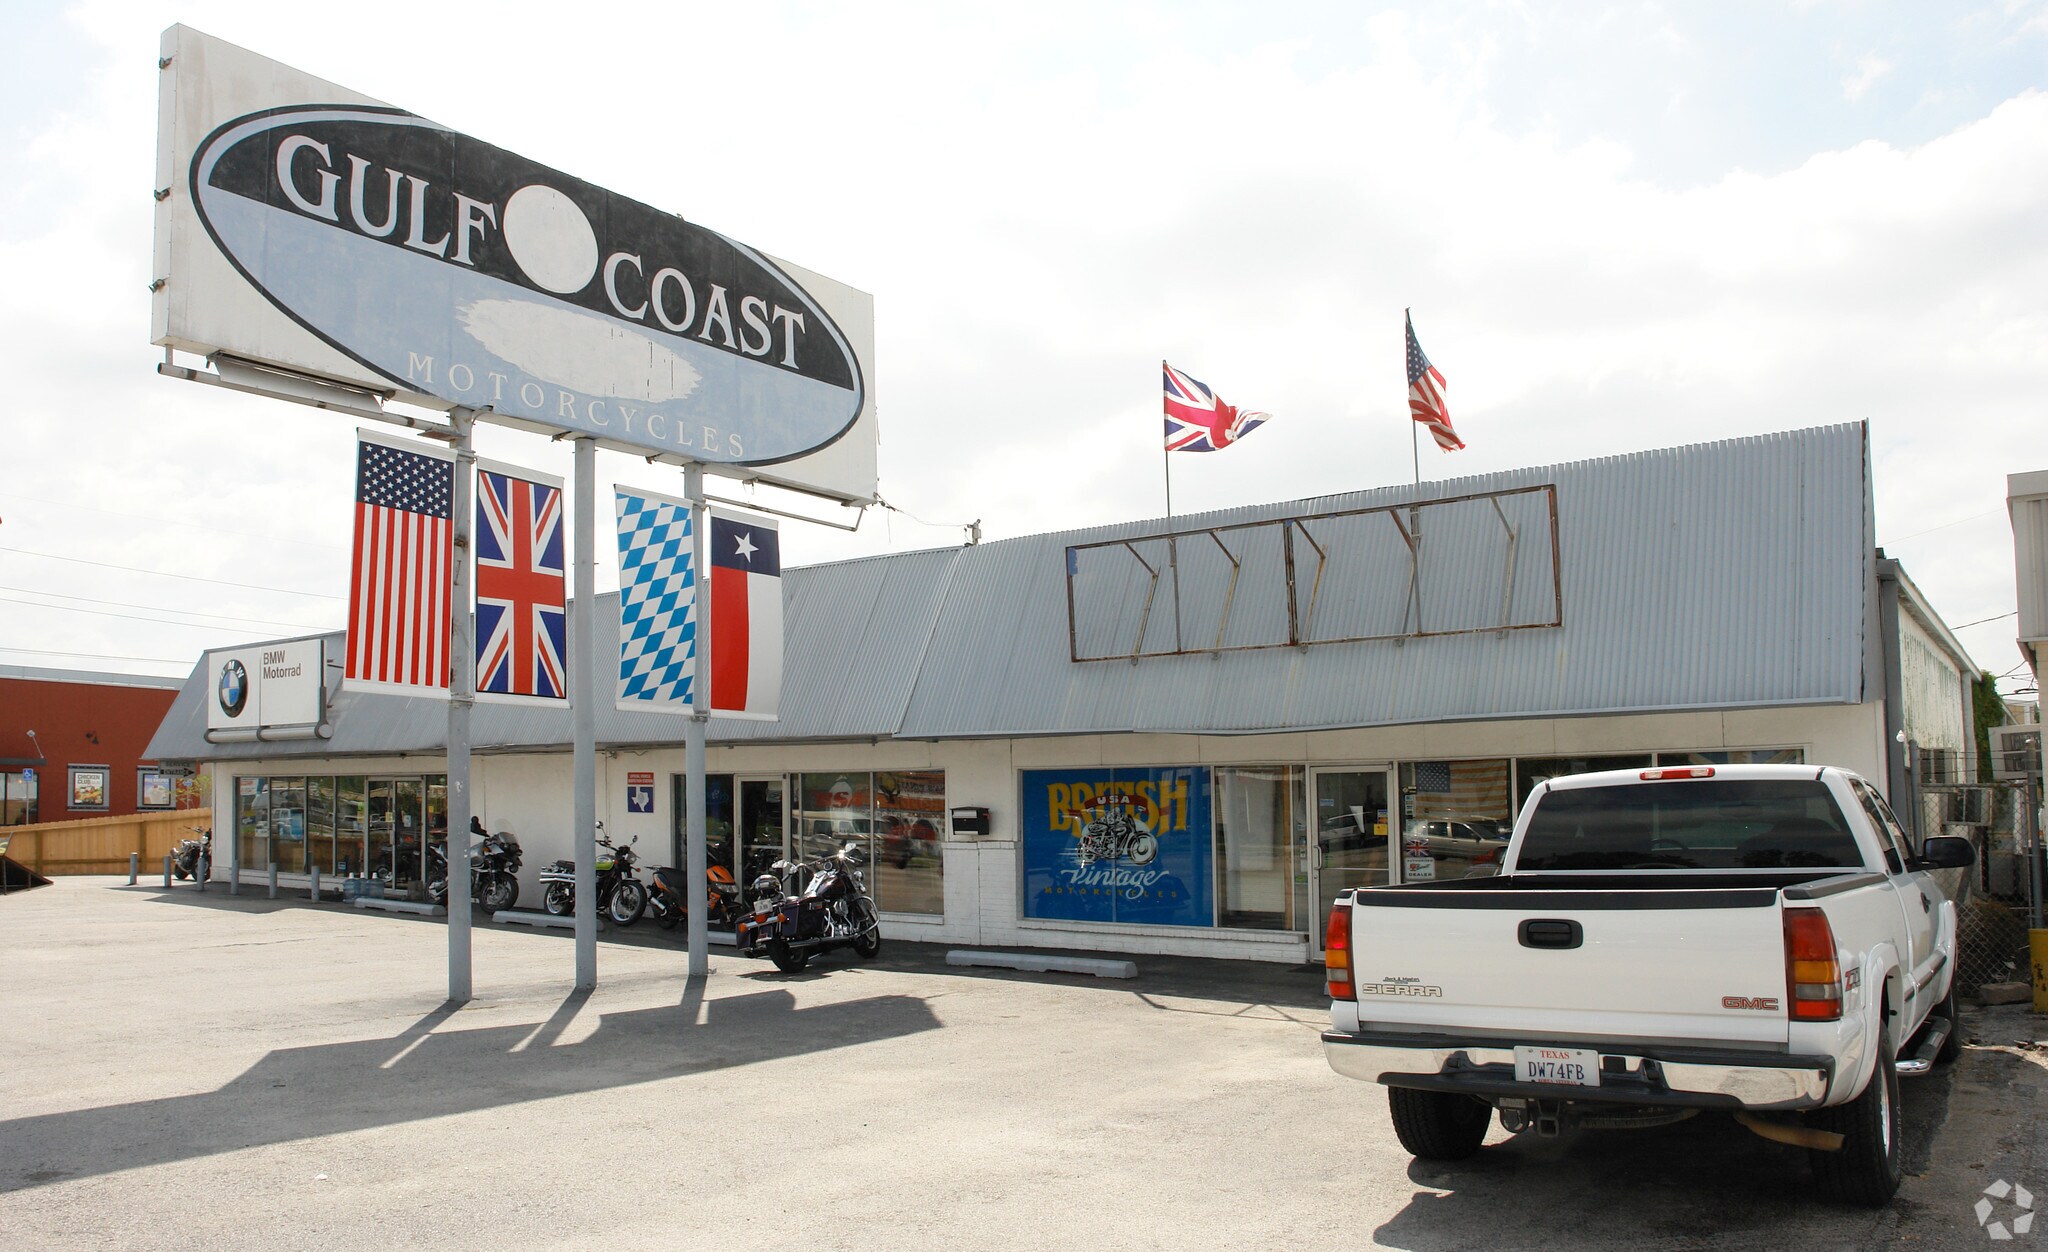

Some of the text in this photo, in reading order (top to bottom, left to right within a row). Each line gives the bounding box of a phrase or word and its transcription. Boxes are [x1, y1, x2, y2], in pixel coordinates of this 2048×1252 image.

[276, 134, 806, 370] GULF COAST
[407, 351, 746, 459] MOTORCYCLES
[263, 650, 286, 665] BMW
[263, 662, 302, 680] Motorrad
[1096, 795, 1130, 804] USA
[1047, 779, 1188, 839] BRITISH
[1044, 885, 1177, 898] MOTORCYCLES
[1060, 866, 1170, 900] Vintage
[1362, 983, 1443, 997] SIERRA
[1721, 995, 1779, 1011] GMC
[1540, 1050, 1570, 1060] TEXAS
[1528, 1061, 1585, 1080] DW74FB
